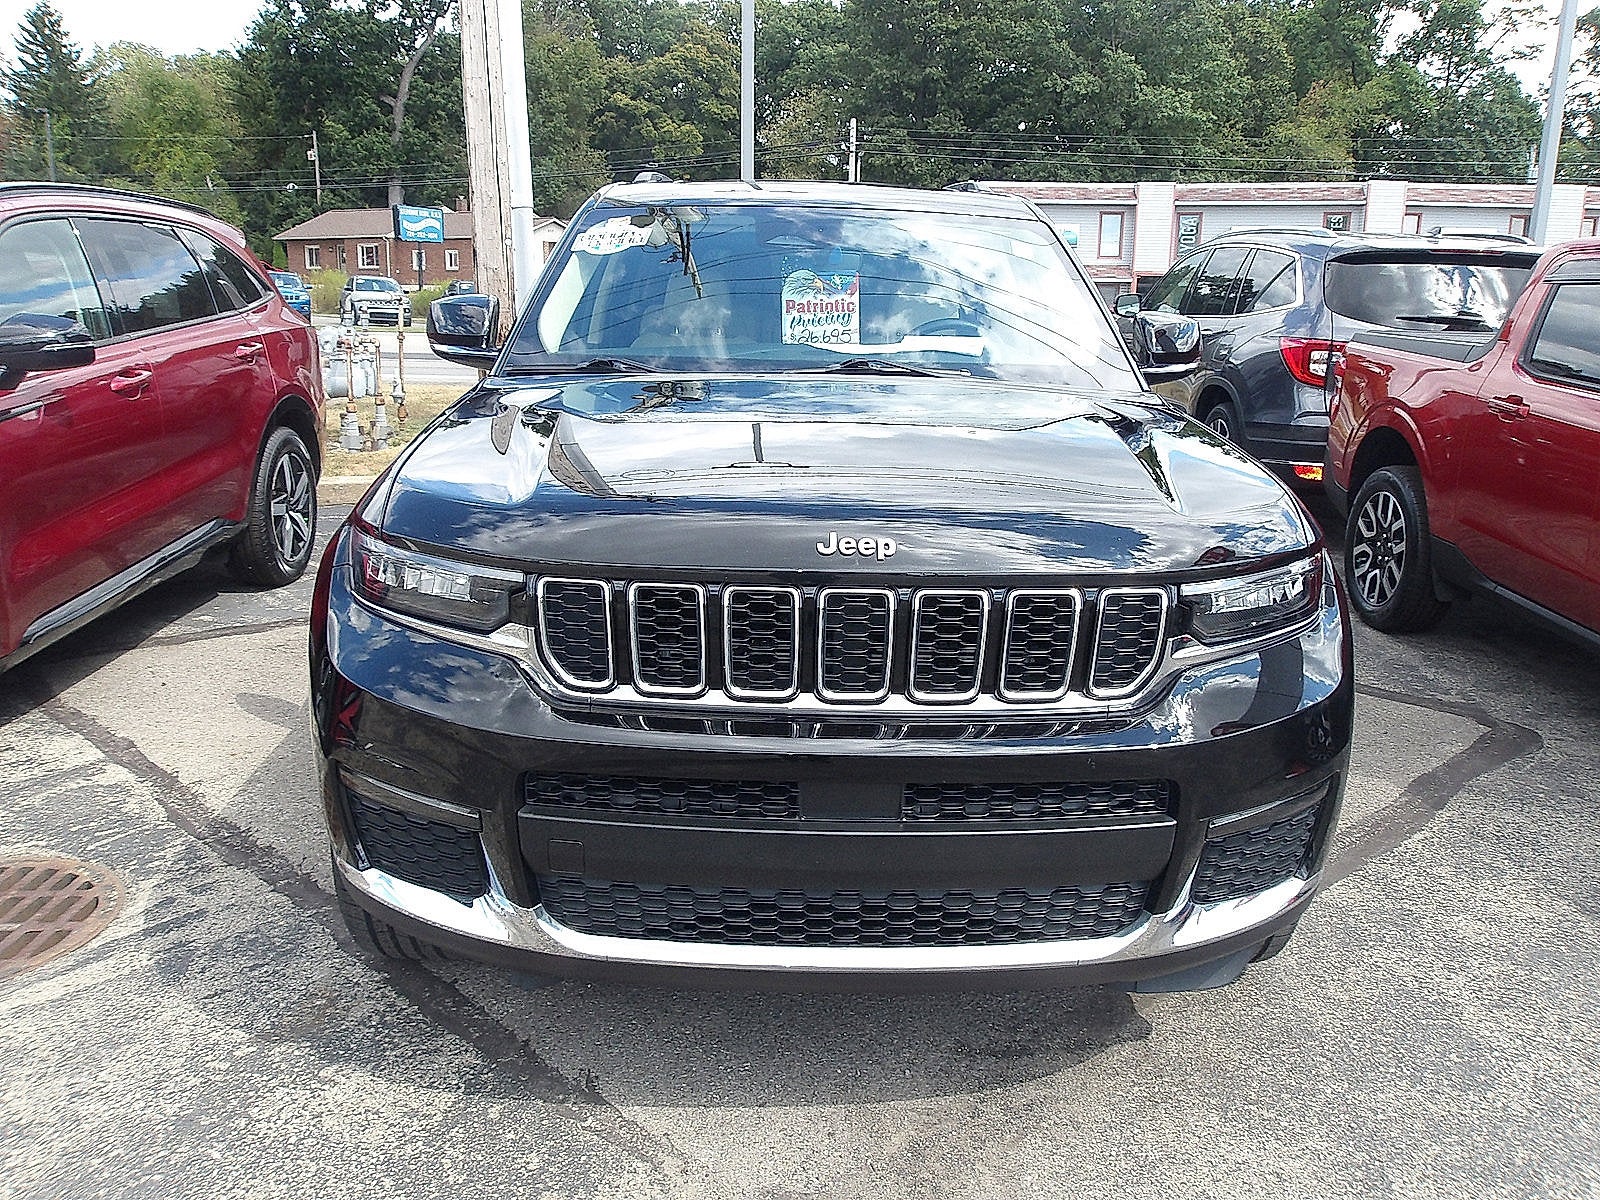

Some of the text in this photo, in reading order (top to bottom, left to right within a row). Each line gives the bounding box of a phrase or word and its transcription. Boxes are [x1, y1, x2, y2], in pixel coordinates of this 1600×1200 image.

[1179, 216, 1199, 253] YOGA
[785, 298, 856, 313] Patriotic
[816, 531, 897, 561] Jeep
